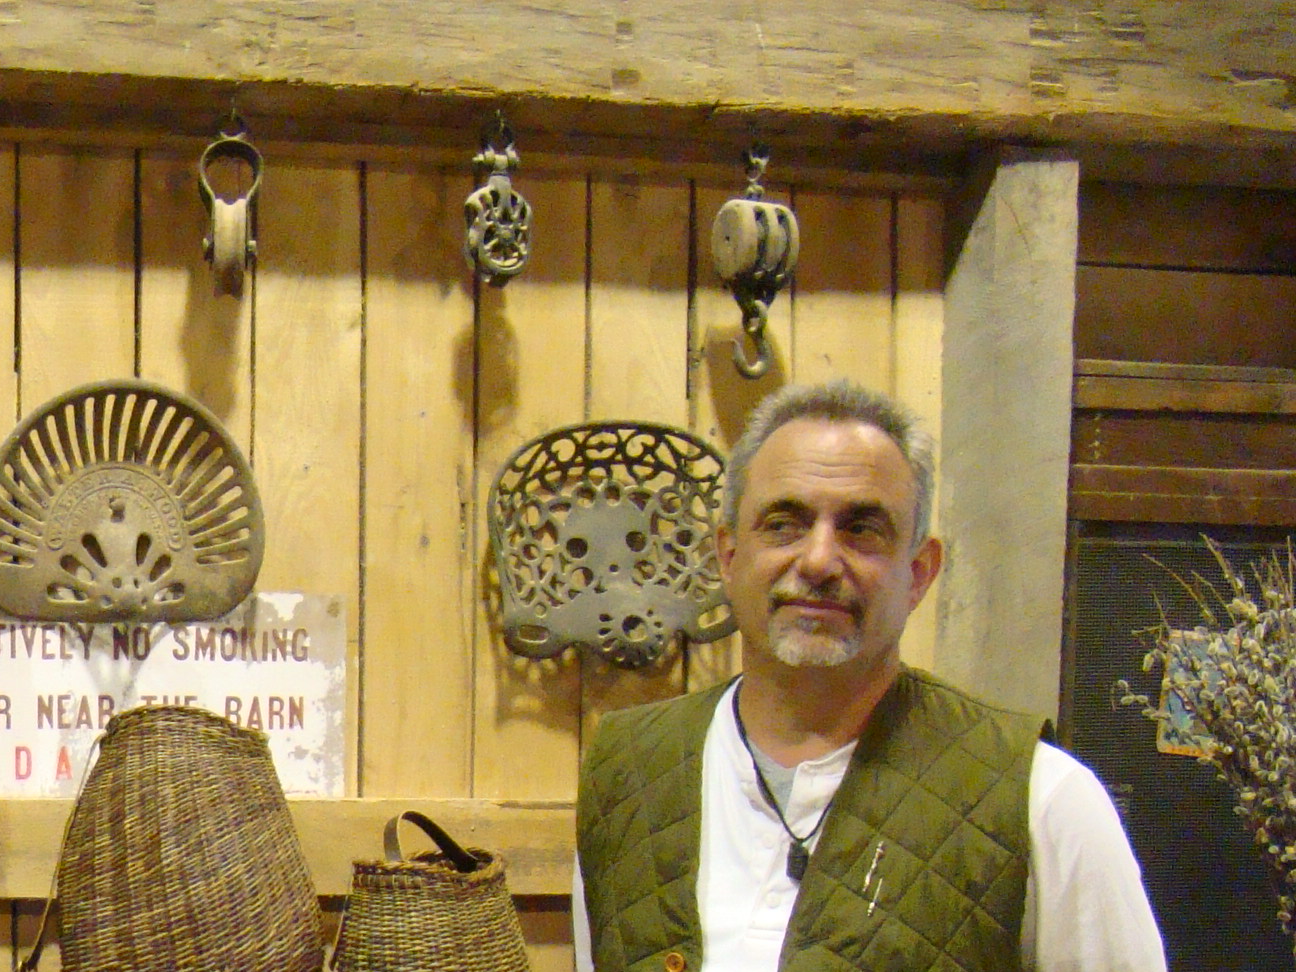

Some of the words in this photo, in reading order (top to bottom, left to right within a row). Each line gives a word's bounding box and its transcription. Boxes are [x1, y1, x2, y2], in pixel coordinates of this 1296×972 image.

[112, 625, 151, 661] NO
[172, 625, 309, 662] SMOKING
[37, 694, 115, 730] NEAR
[225, 695, 304, 730] BARN
